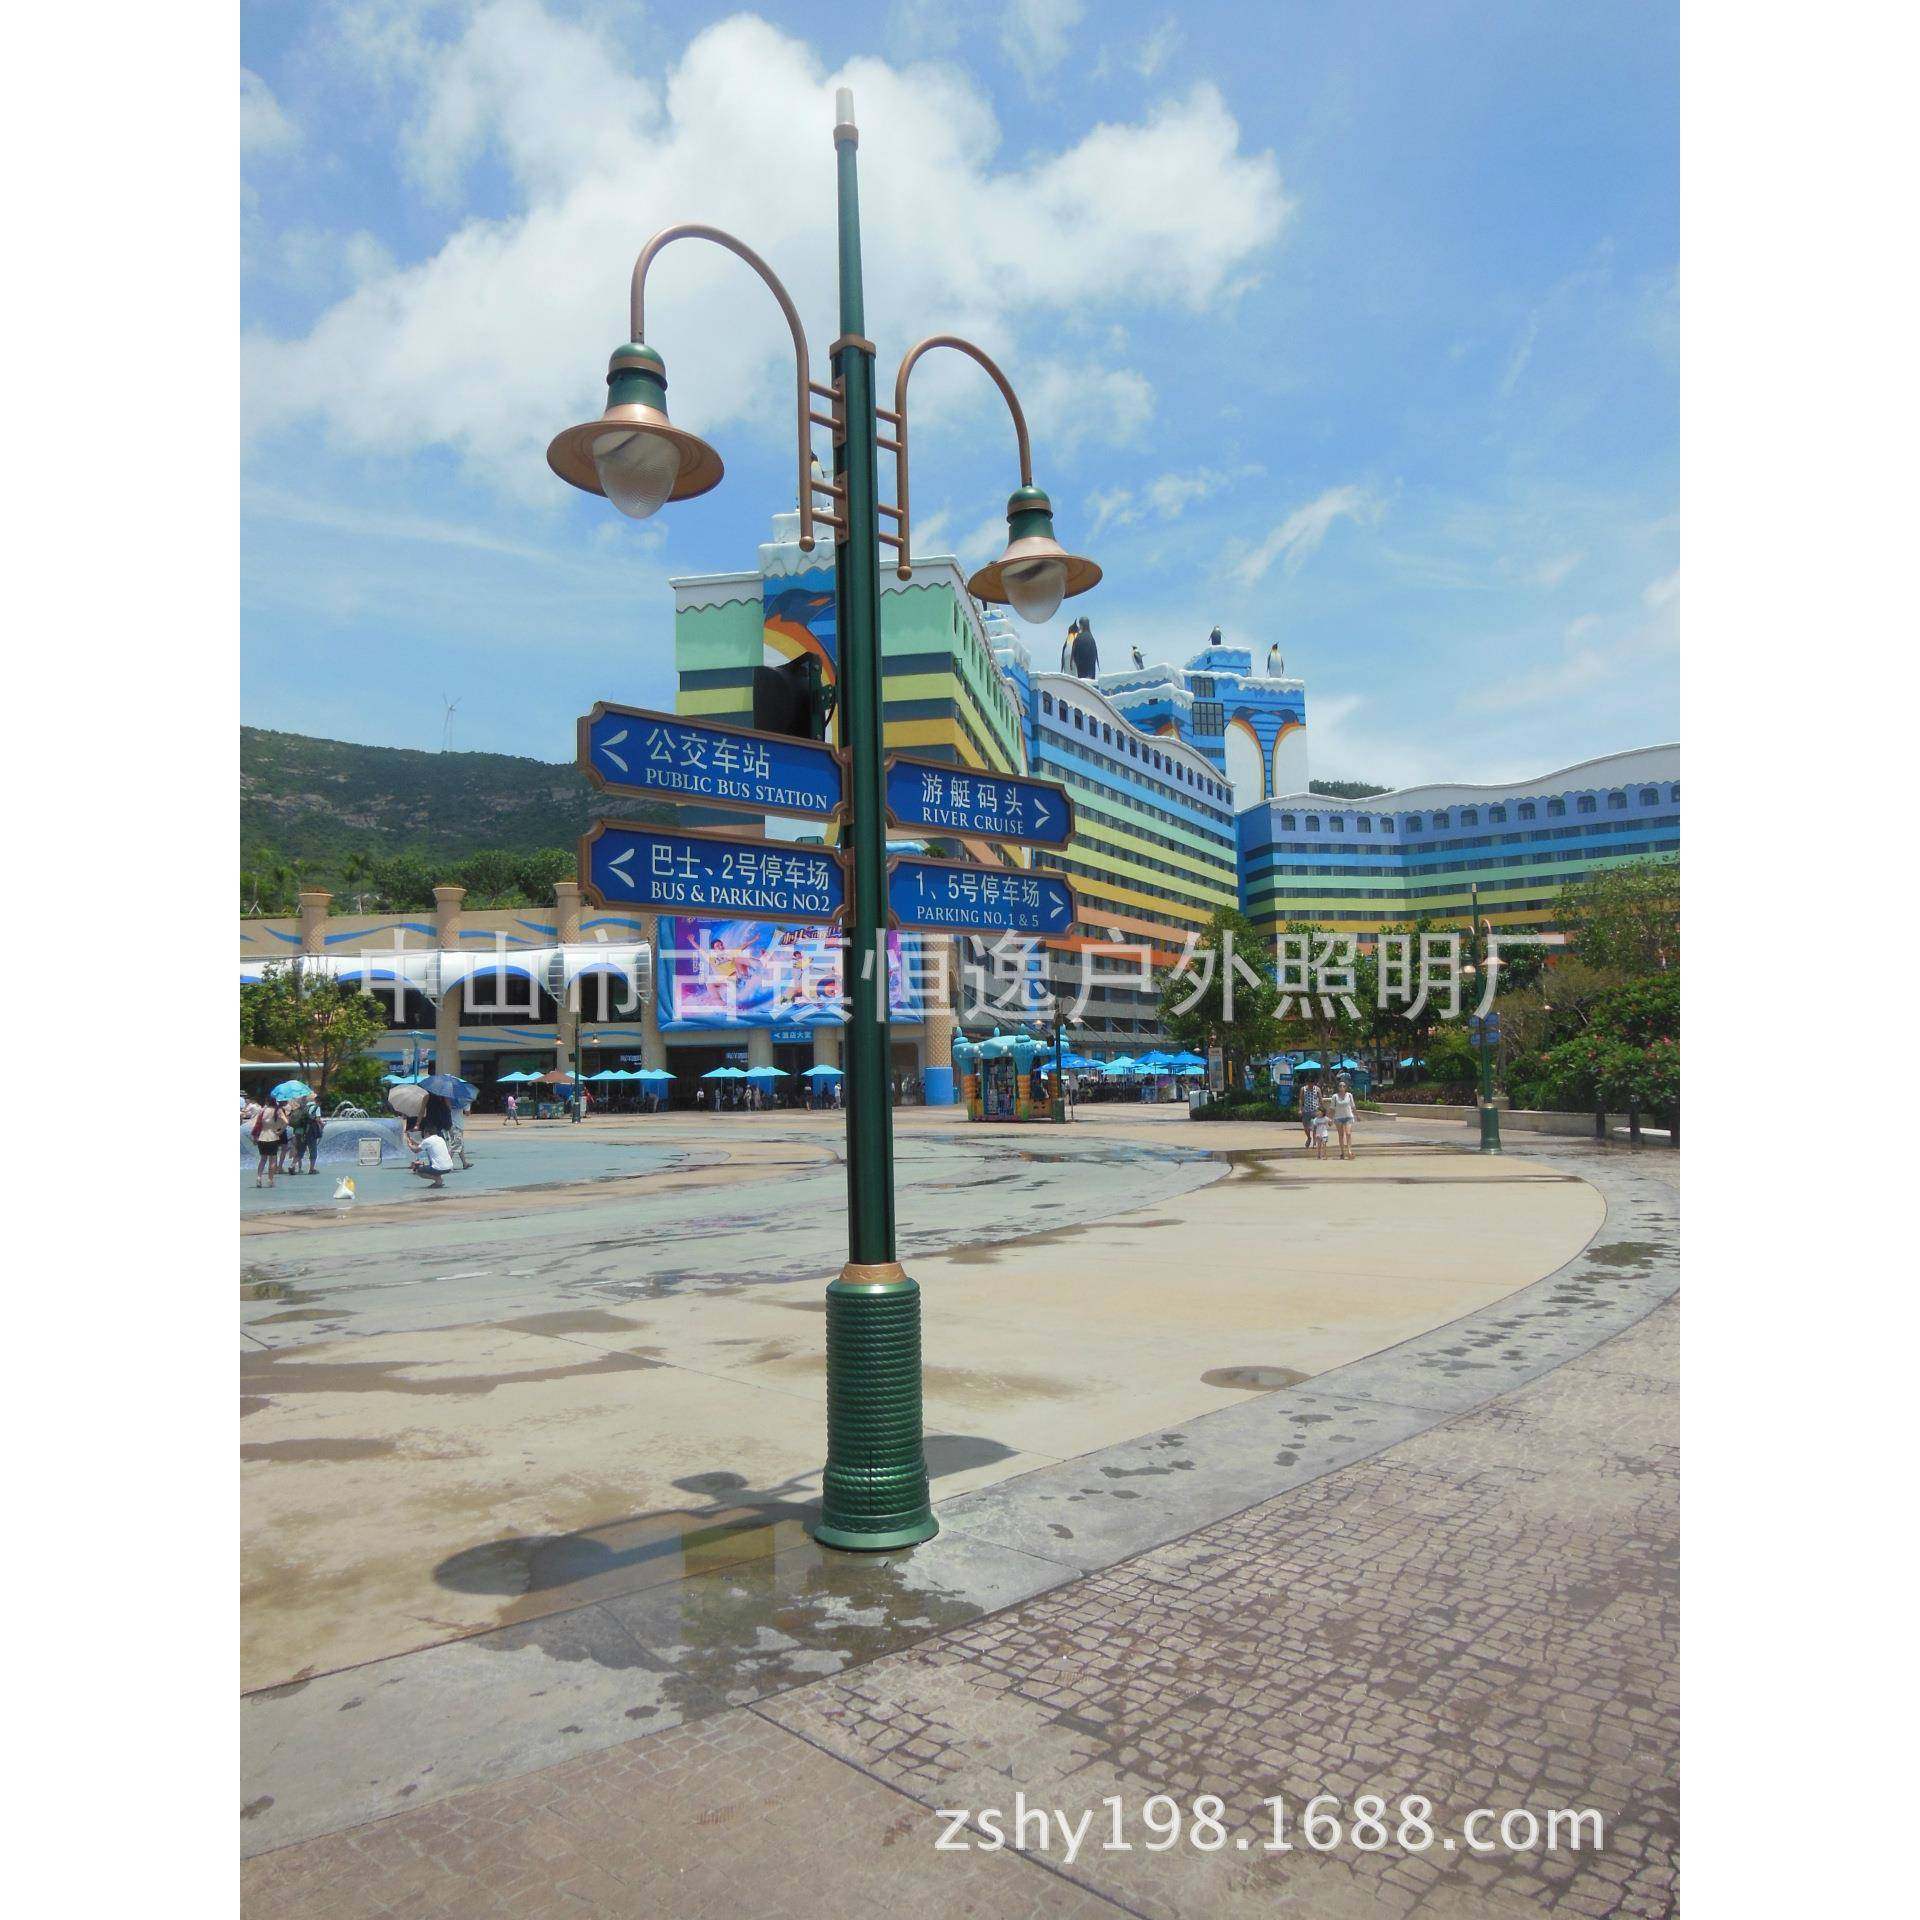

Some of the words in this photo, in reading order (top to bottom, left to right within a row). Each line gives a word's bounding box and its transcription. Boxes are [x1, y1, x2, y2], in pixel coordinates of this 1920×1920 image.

[646, 728, 770, 780] 公交车站
[645, 768, 712, 792] PUBLIC
[717, 778, 750, 798] BUS
[756, 785, 827, 809] STATION
[922, 772, 1023, 816] 游艇码头
[922, 806, 969, 827] RIVER
[974, 814, 1024, 835] CRUISE
[652, 844, 829, 891] 巴士、2号停车场
[651, 881, 685, 901] BUS
[690, 884, 705, 903] &
[710, 886, 787, 909] PARKING
[793, 893, 829, 912] NO.2
[916, 871, 1039, 907] 1、5号停车场
[917, 905, 979, 924] PARKING
[1018, 913, 1028, 927] &
[1032, 914, 1039, 927] 5
